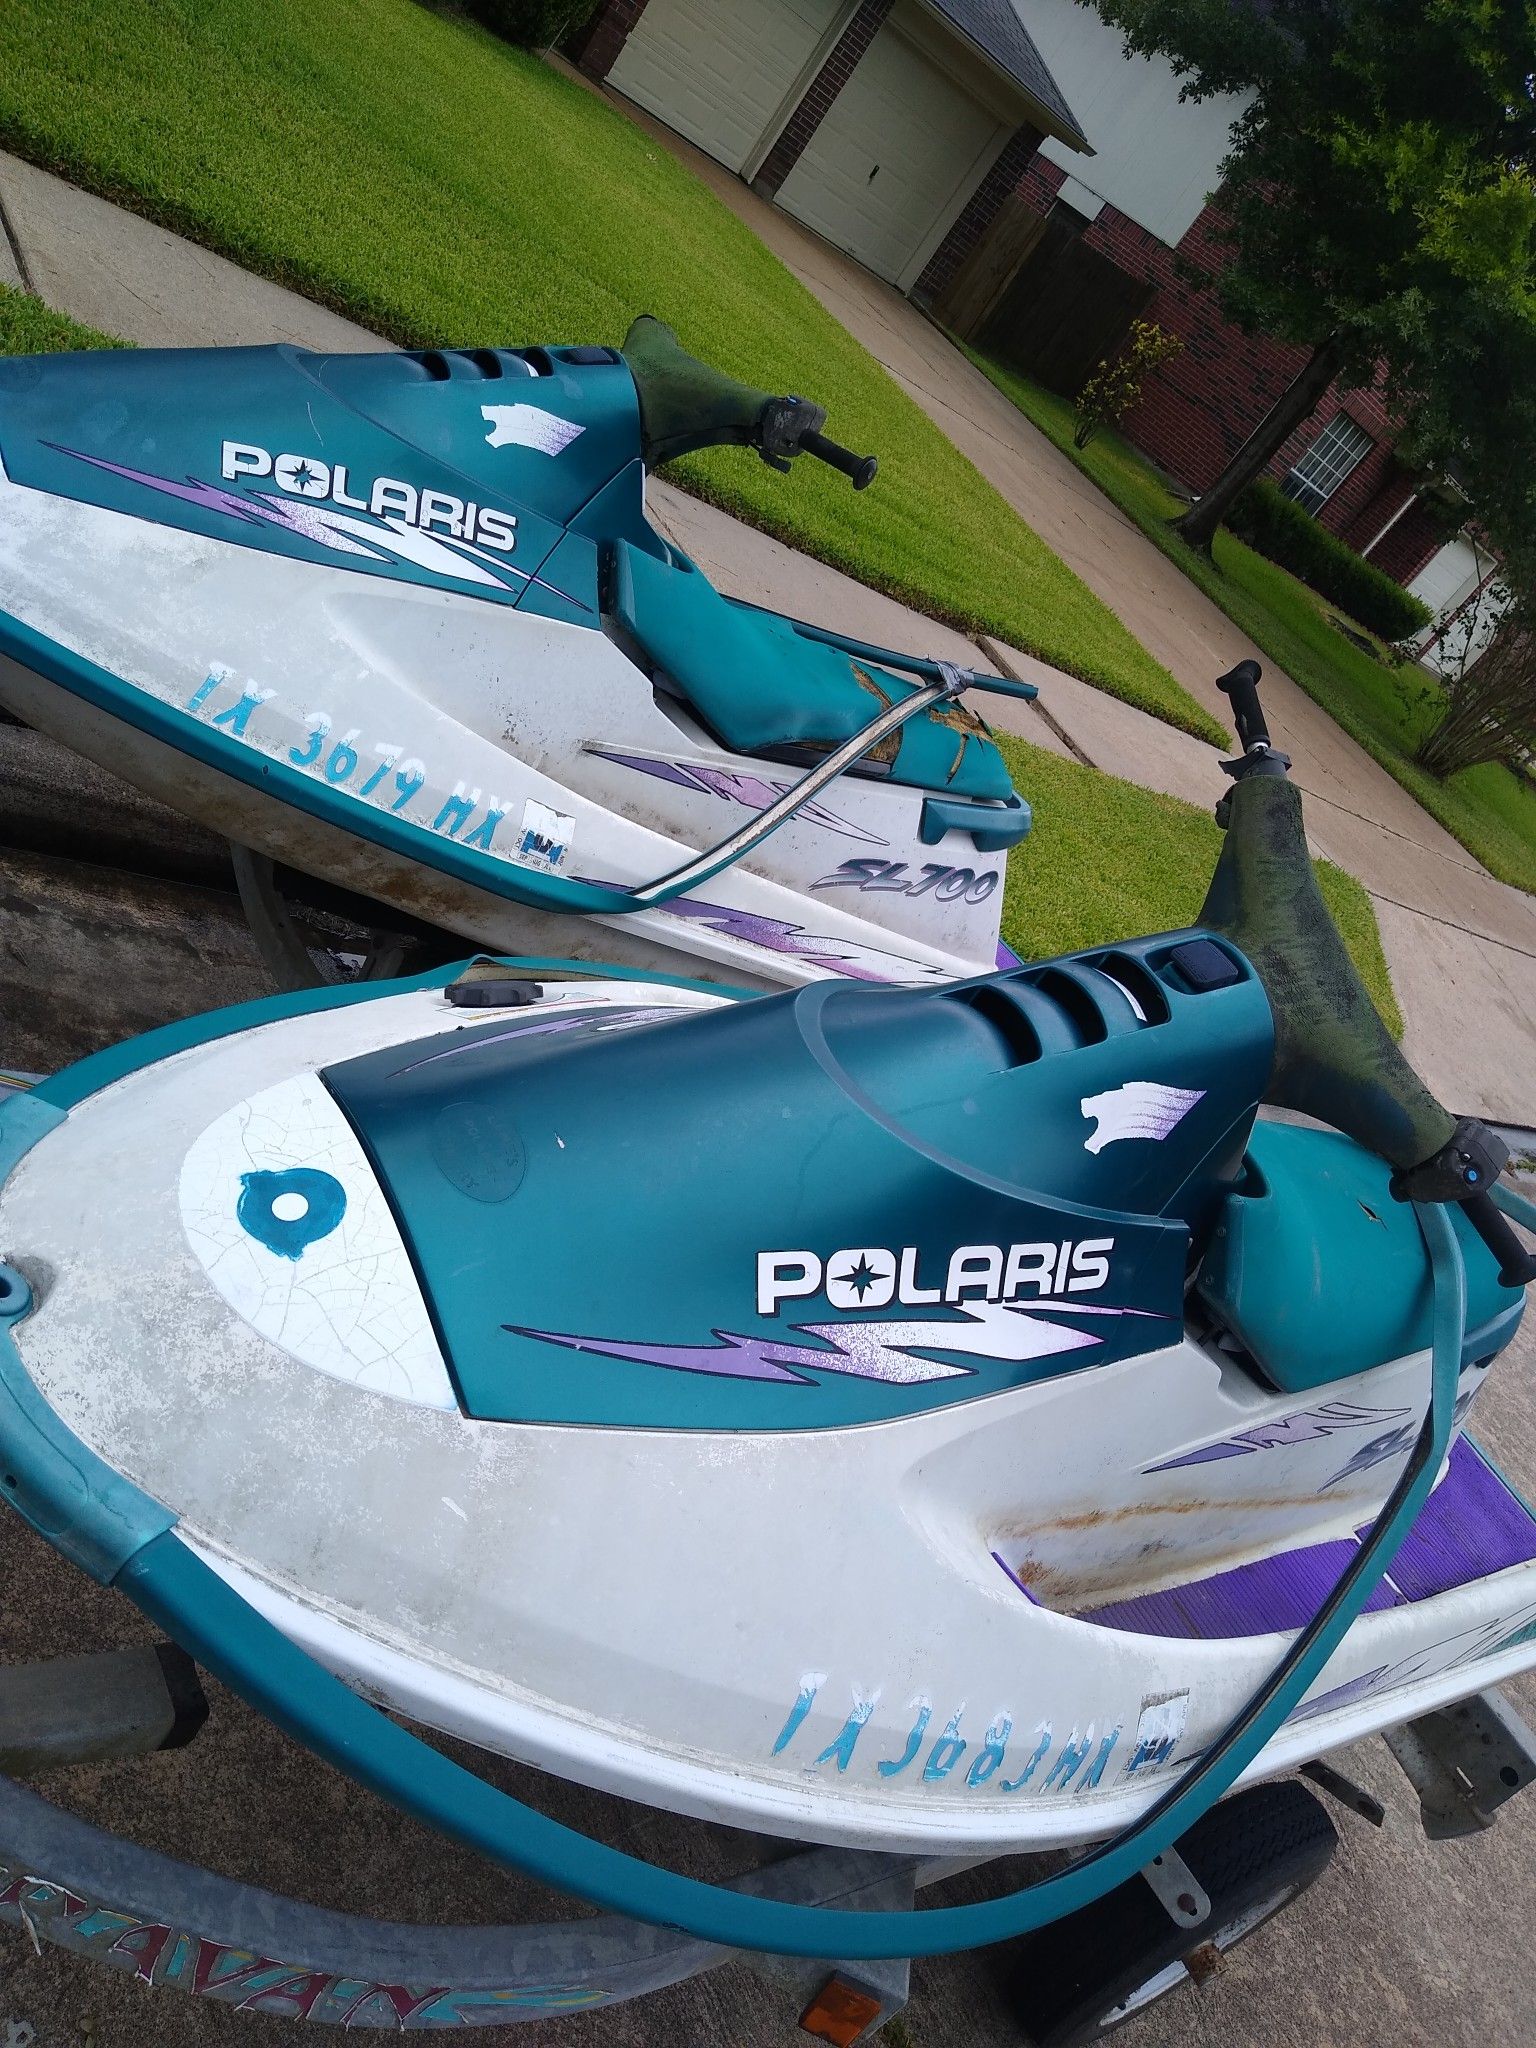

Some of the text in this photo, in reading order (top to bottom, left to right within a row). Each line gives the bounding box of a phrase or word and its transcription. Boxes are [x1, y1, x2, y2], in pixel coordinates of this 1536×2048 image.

[221, 440, 518, 552] POLARIS
[289, 711, 427, 811] 3679
[757, 1238, 1114, 1317] POLARIS
